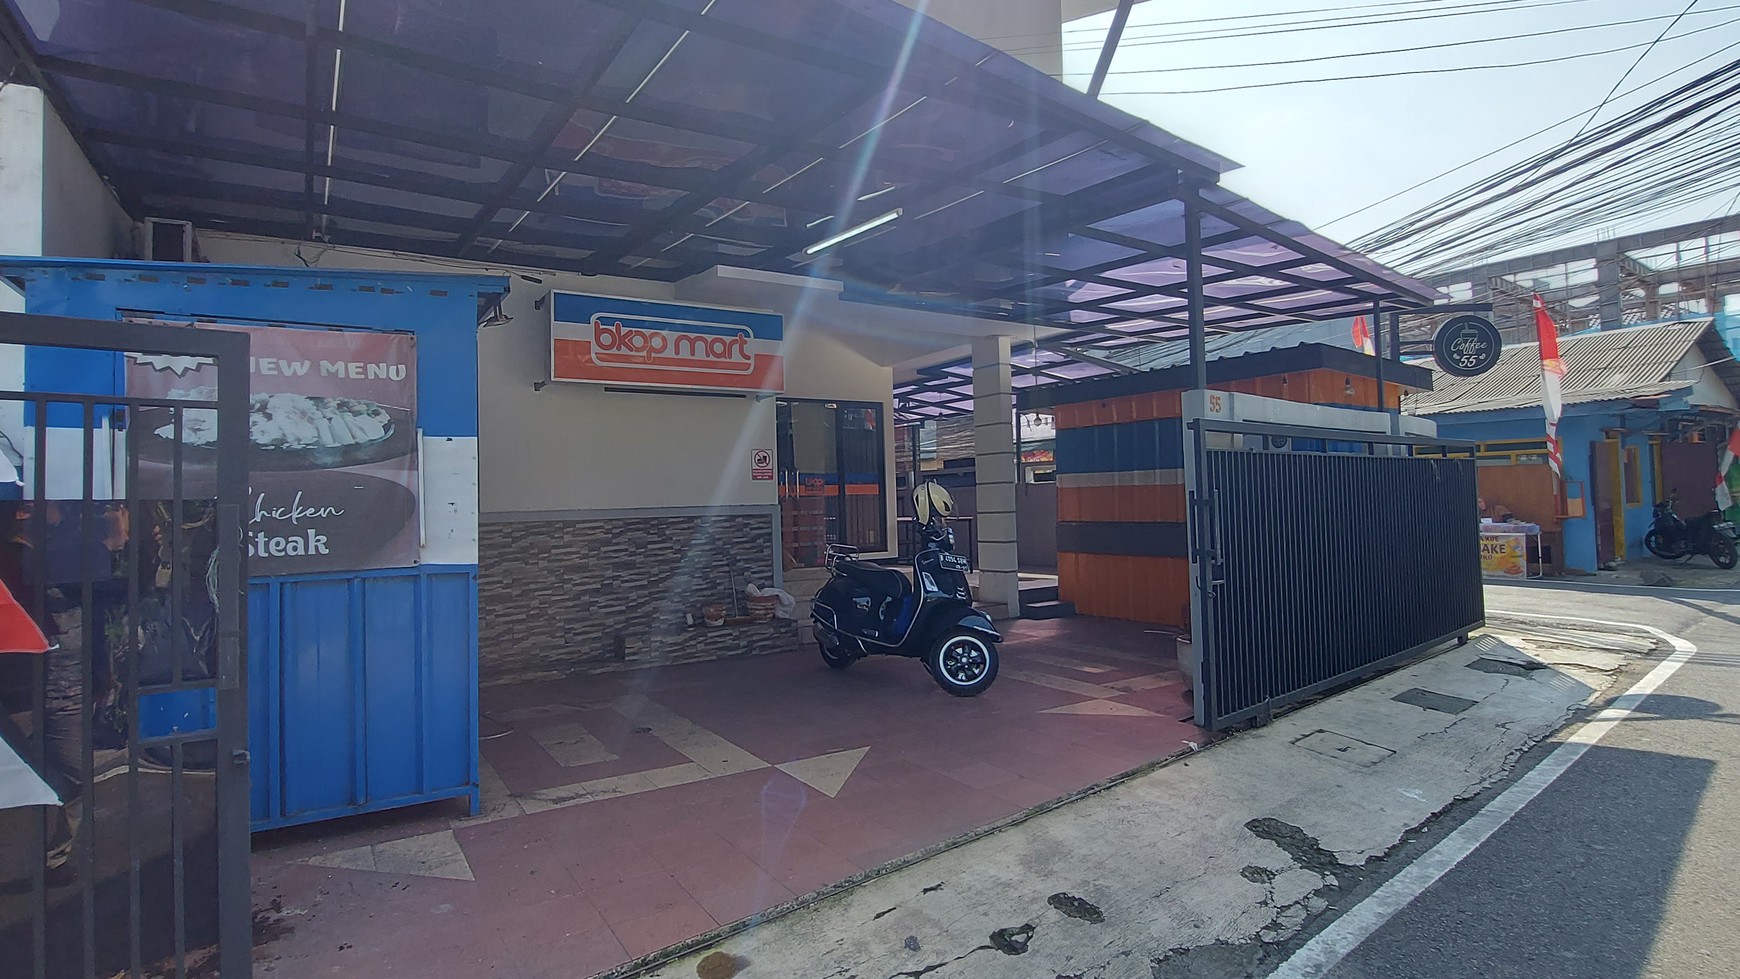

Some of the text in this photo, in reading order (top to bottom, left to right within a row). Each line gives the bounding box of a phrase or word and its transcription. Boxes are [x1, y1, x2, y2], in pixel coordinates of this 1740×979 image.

[674, 332, 752, 361] mart
[1451, 337, 1488, 354] Coffee
[320, 359, 407, 381] MENU
[1459, 355, 1478, 367] 55
[1209, 394, 1222, 414] 55
[249, 486, 345, 524] hicken
